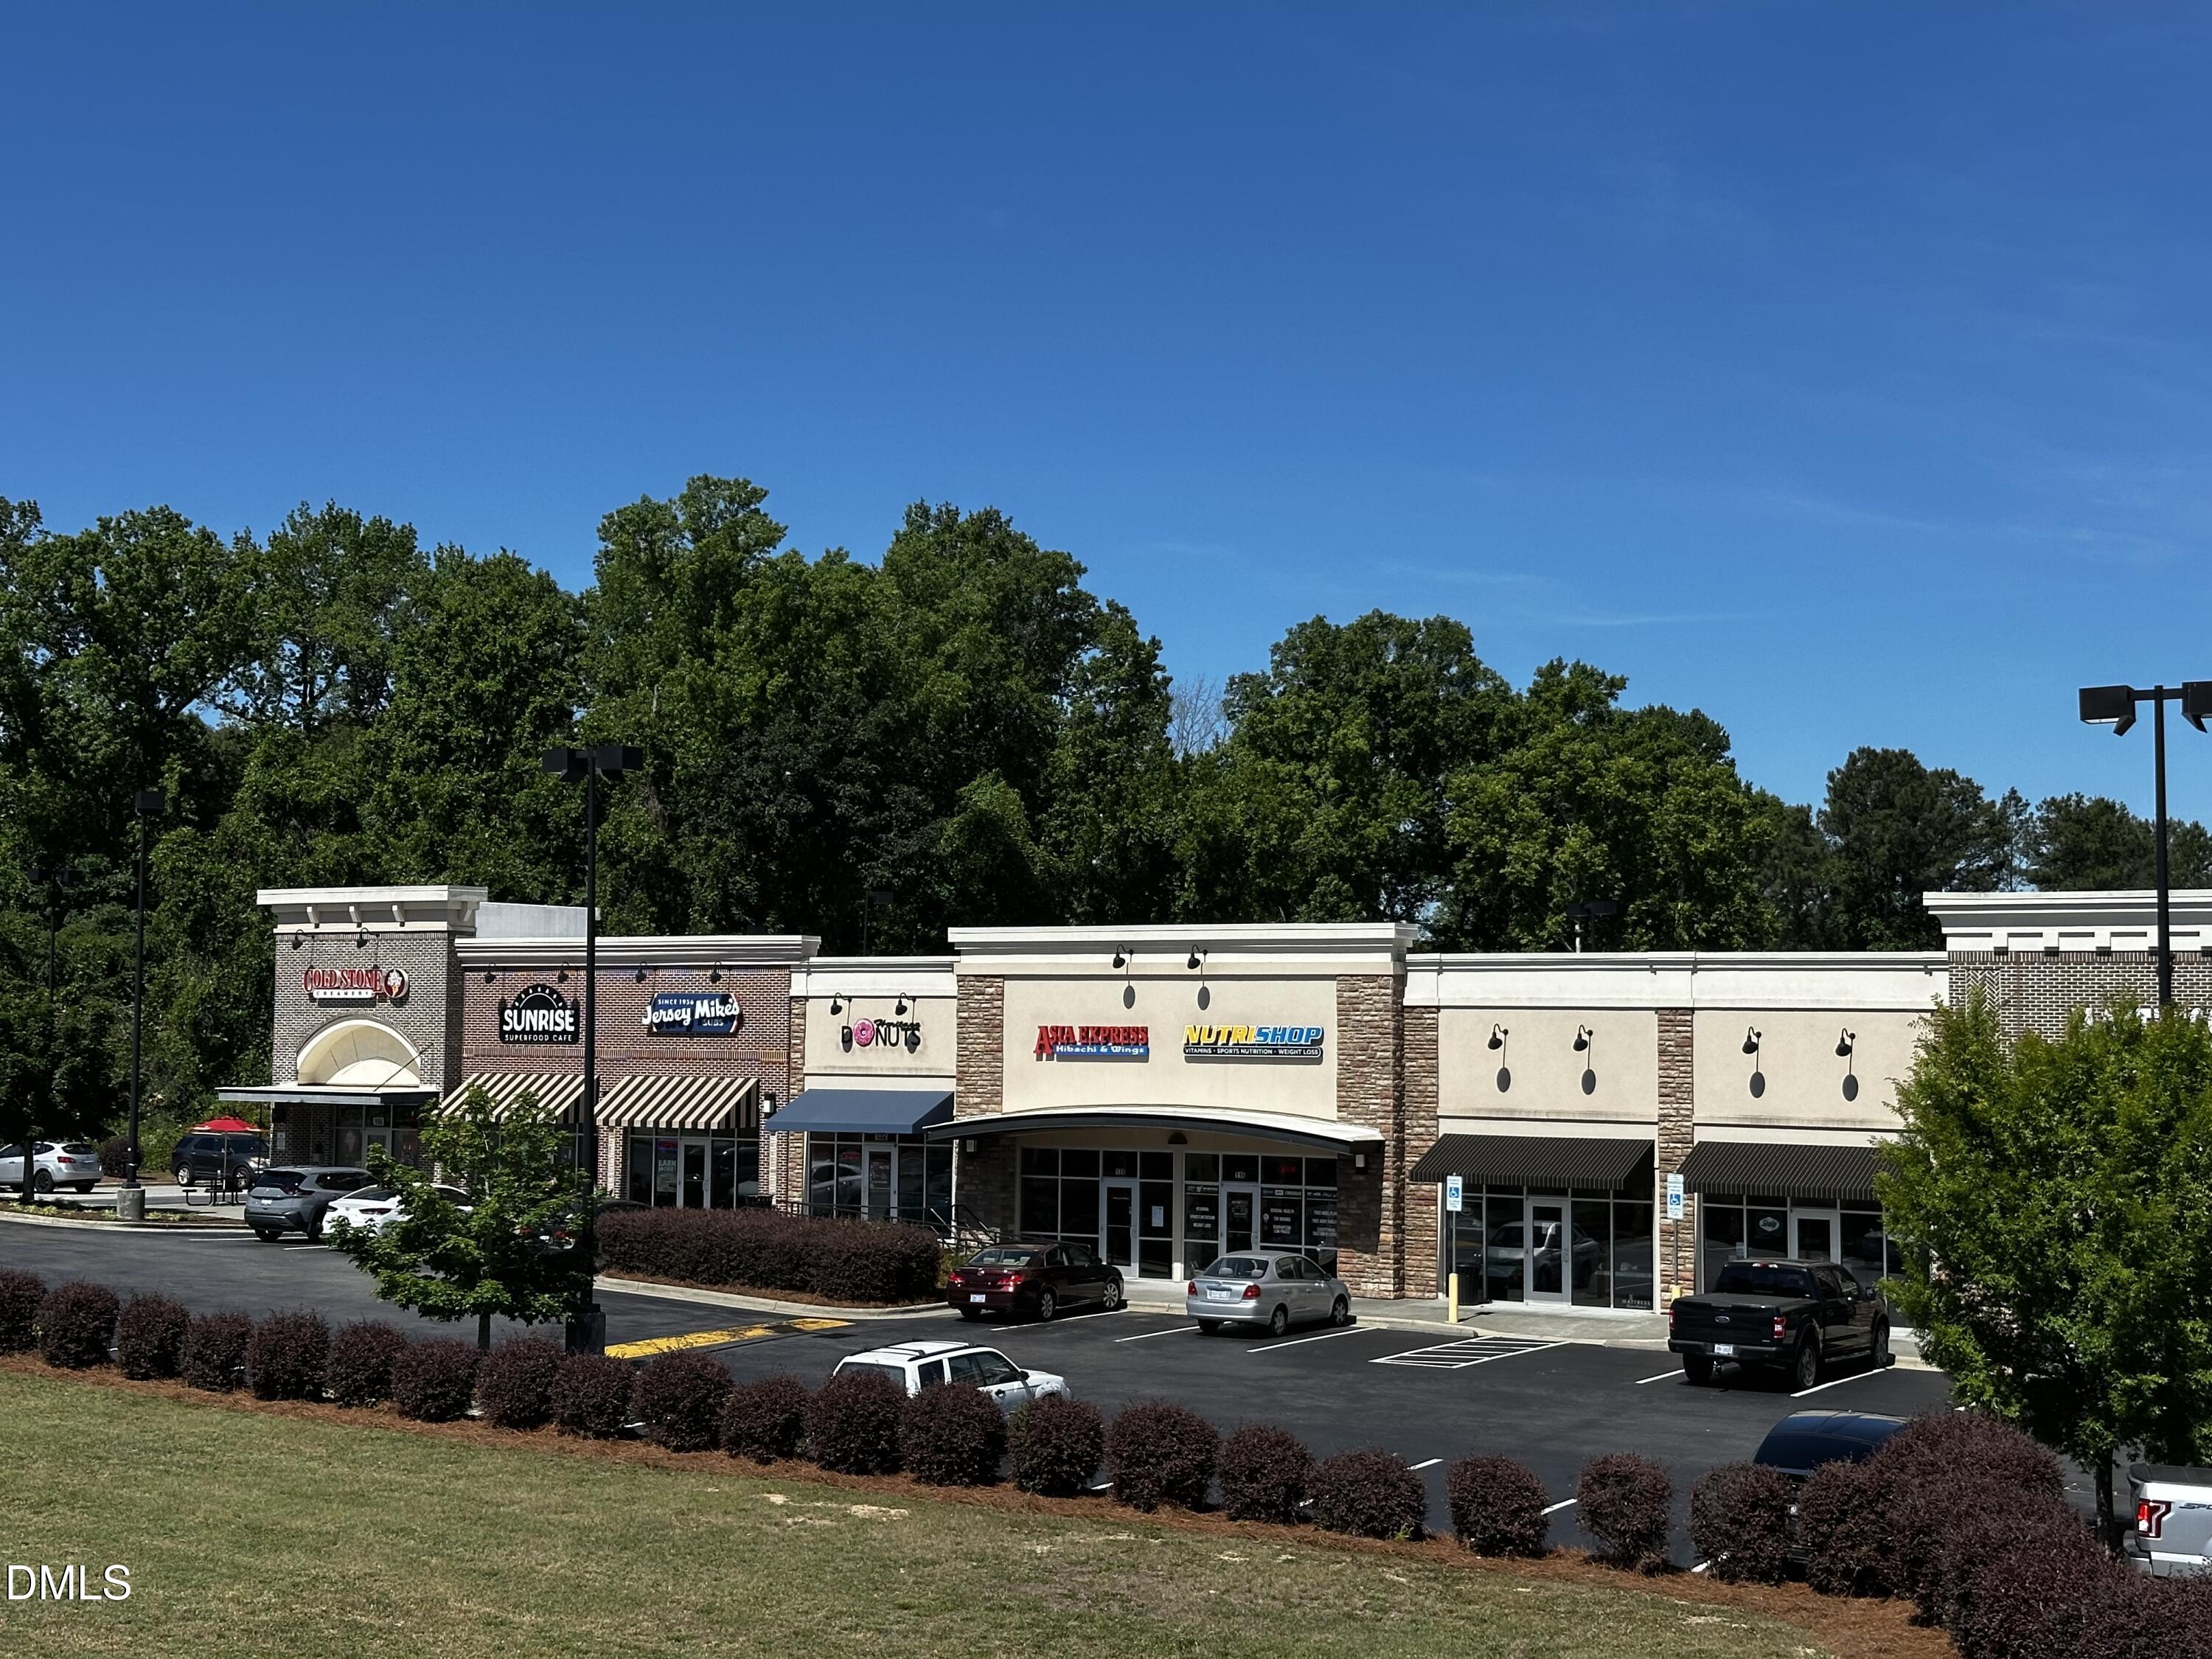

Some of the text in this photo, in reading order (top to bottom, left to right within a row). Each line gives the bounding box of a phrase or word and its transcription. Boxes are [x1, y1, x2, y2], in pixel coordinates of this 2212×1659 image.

[304, 969, 383, 992] COLD STONE
[503, 1009, 575, 1032] SUNRISE
[641, 998, 740, 1026] Jersey Mike's
[703, 1018, 723, 1026] SUBS
[1034, 1026, 1149, 1054] ASIA EXPRESS
[1181, 1025, 1325, 1045] NUTRISHOP
[1111, 1046, 1145, 1055] Wings
